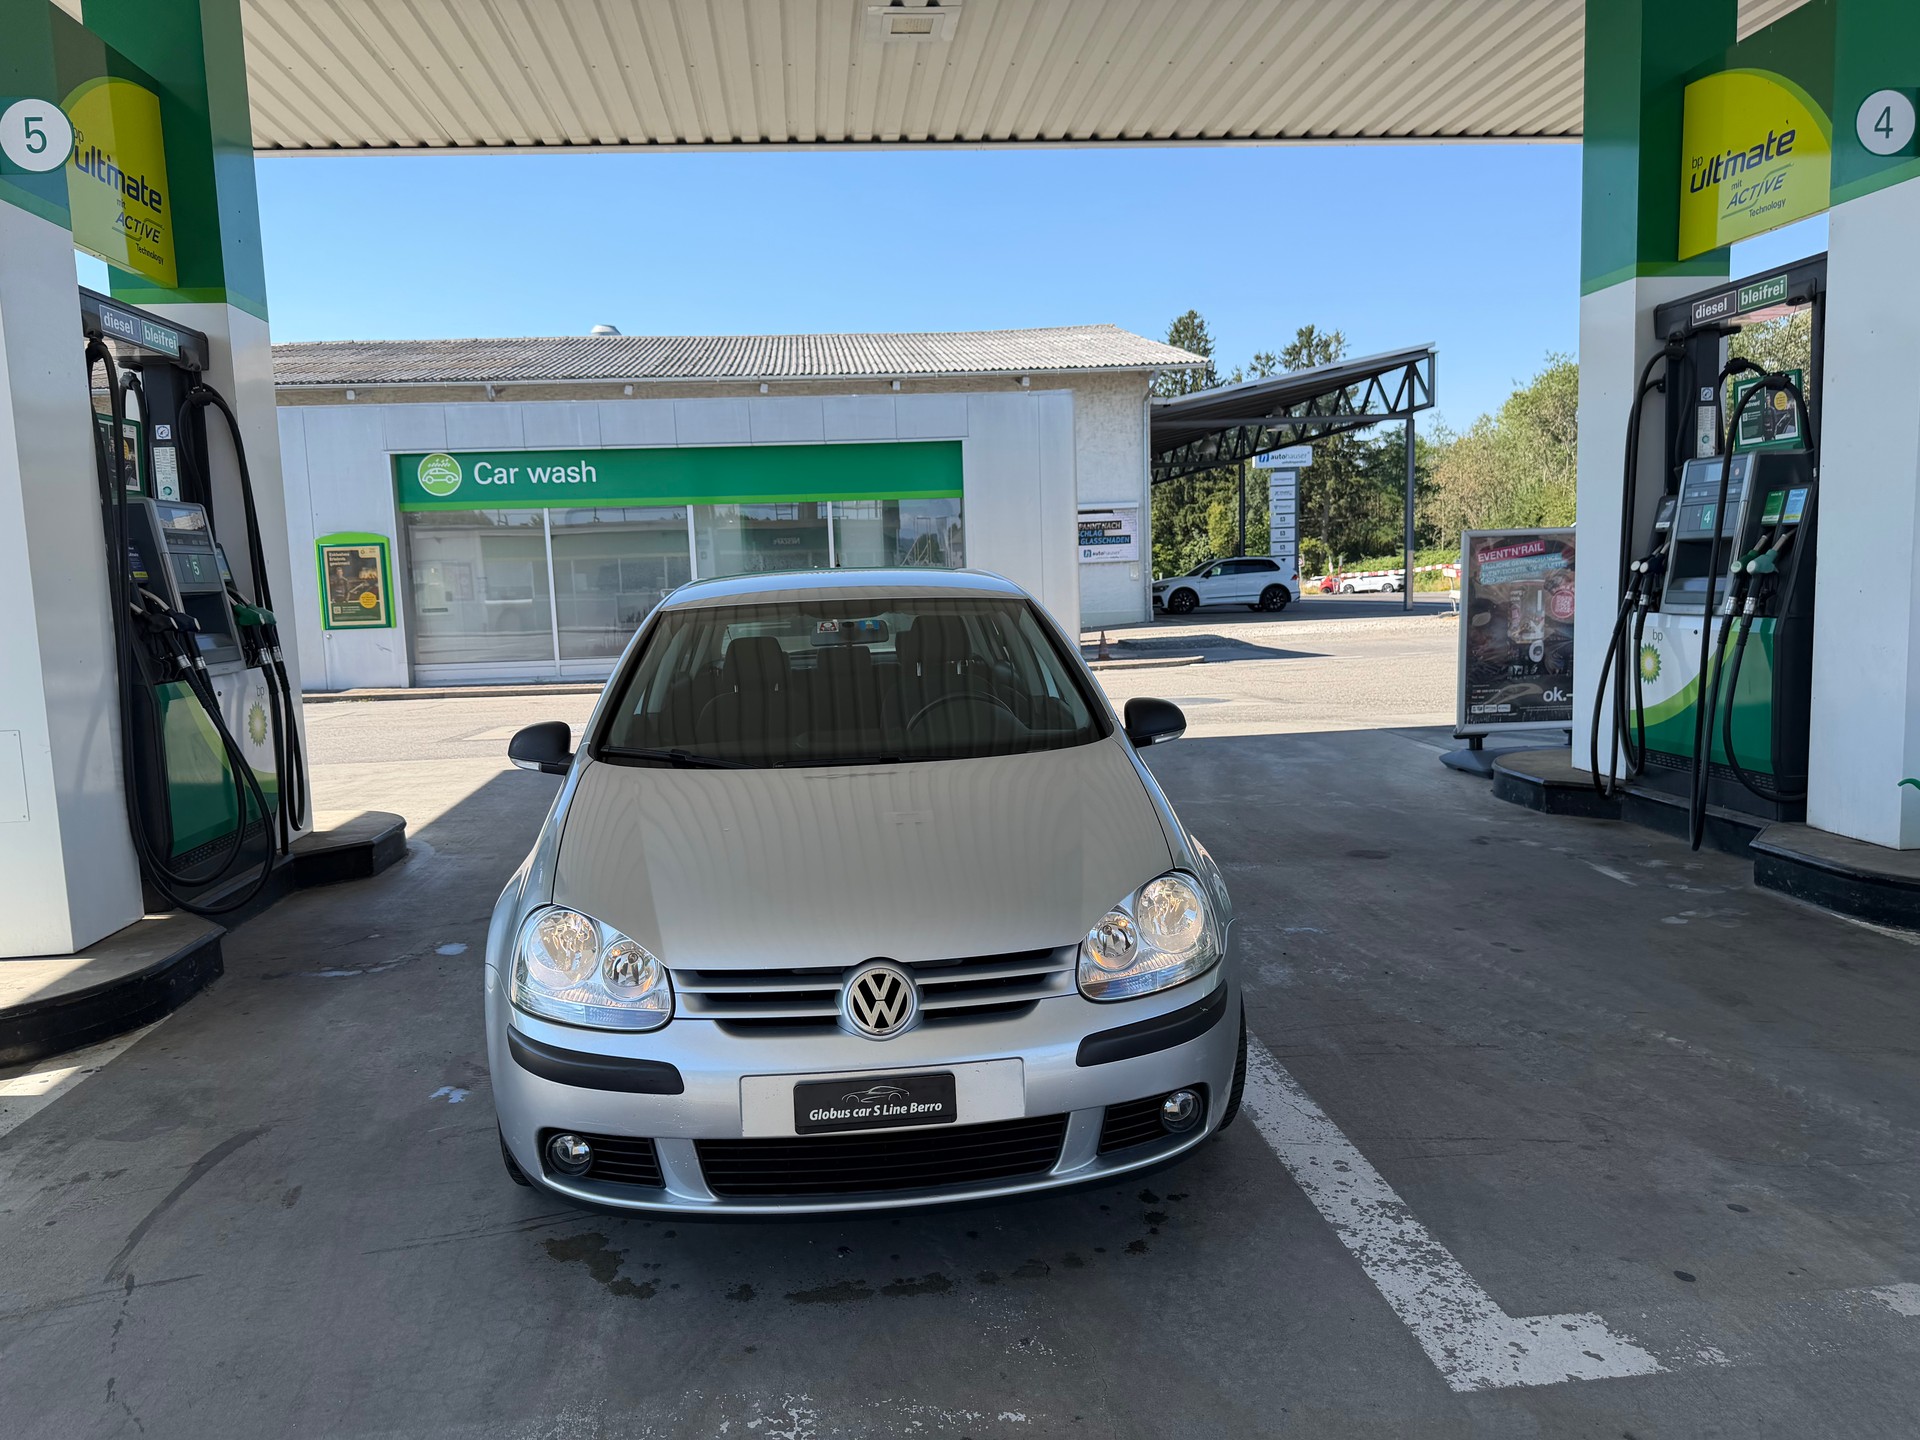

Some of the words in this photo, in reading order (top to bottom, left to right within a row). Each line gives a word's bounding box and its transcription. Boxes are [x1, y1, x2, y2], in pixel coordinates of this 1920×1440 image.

[1873, 106, 1894, 139] 4
[25, 116, 47, 153] 5
[1689, 128, 1796, 193] ultimate
[1691, 156, 1703, 169] bp
[74, 144, 162, 214] ultimate
[1731, 180, 1742, 190] mit
[1727, 172, 1786, 209] ACTIVE
[1749, 198, 1786, 218] Technology
[115, 211, 161, 244] ACTIVE
[136, 242, 164, 265] Technology
[1741, 280, 1784, 306] bleifrei
[1695, 298, 1727, 319] diesel
[104, 312, 133, 335] diesel
[144, 328, 177, 349] bleifrei
[474, 461, 519, 485] Car
[527, 460, 597, 484] wash
[1102, 521, 1121, 529] NACH
[1703, 510, 1711, 523] 4
[1081, 537, 1130, 545] GLASSCHADEN
[1478, 543, 1543, 562] EVENT'N'RAIL
[192, 562, 200, 576] 5
[1652, 629, 1663, 643] bp
[256, 685, 265, 697] bp
[809, 1107, 851, 1121] Globus
[853, 1107, 872, 1117] car
[873, 1105, 880, 1116] S
[882, 1104, 907, 1115] Line
[910, 1102, 942, 1114] Berro
